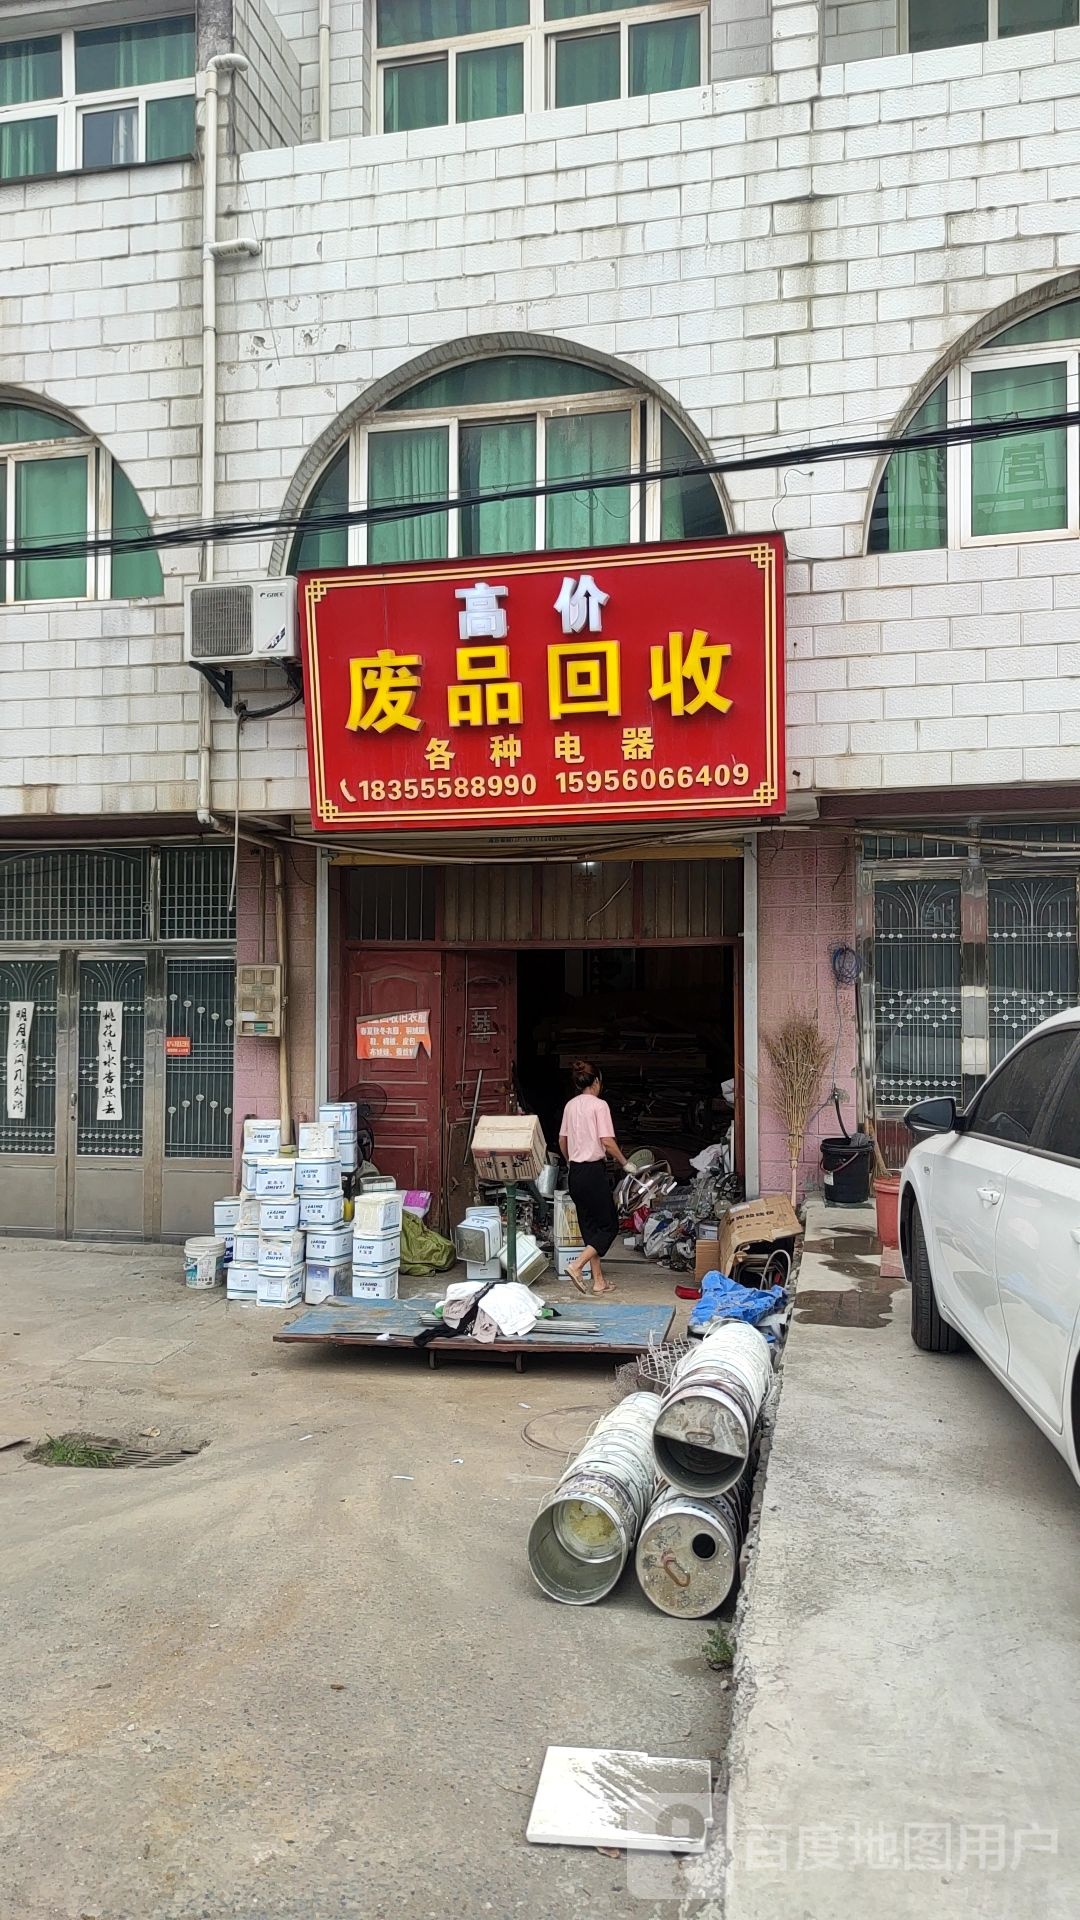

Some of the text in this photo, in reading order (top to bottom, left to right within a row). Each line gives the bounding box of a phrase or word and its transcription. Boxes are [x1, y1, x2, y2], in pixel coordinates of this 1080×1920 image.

[454, 574, 609, 640] 高价
[345, 628, 733, 734] 废品回收
[424, 727, 655, 771] 各种电器
[358, 763, 749, 801] 18355588990 15956066409
